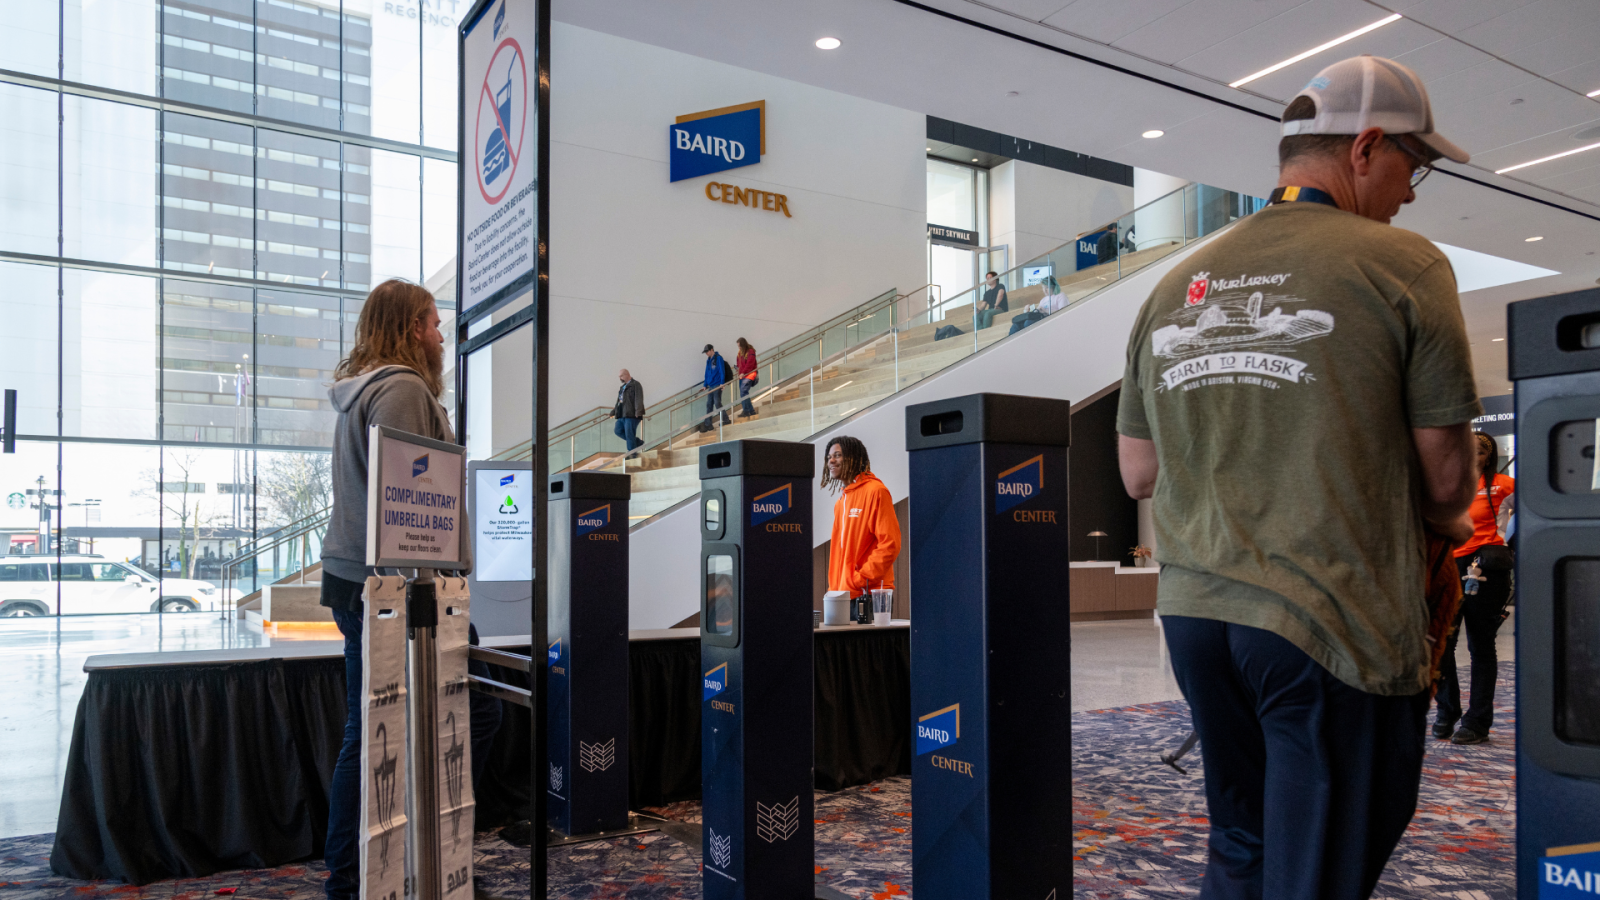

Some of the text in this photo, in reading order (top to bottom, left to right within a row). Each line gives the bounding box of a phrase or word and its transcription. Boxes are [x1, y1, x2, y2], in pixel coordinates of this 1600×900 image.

[675, 129, 745, 163] BAIRD
[705, 181, 792, 218] CENTER
[474, 217, 491, 238] OUTSIDE
[491, 207, 504, 224] FOOD
[945, 230, 970, 241] SKYWALK
[1169, 355, 1293, 385] FARM TO FLASK
[997, 482, 1033, 498] BAIRD
[385, 486, 457, 510] COMPLIMENTARY
[753, 503, 783, 514] BAIRD
[384, 510, 454, 532] UMBRELLA BAGS
[578, 519, 603, 527] BAIRD
[1013, 510, 1057, 525] CENTER
[765, 523, 803, 534] CENTER
[405, 532, 420, 541] Please
[420, 534, 429, 543] help
[589, 533, 619, 542] CENTER
[398, 543, 442, 554] keep our floors clean.
[704, 679, 721, 692] BAIRD
[918, 725, 949, 744] BAIRD
[931, 755, 974, 779] CENTER
